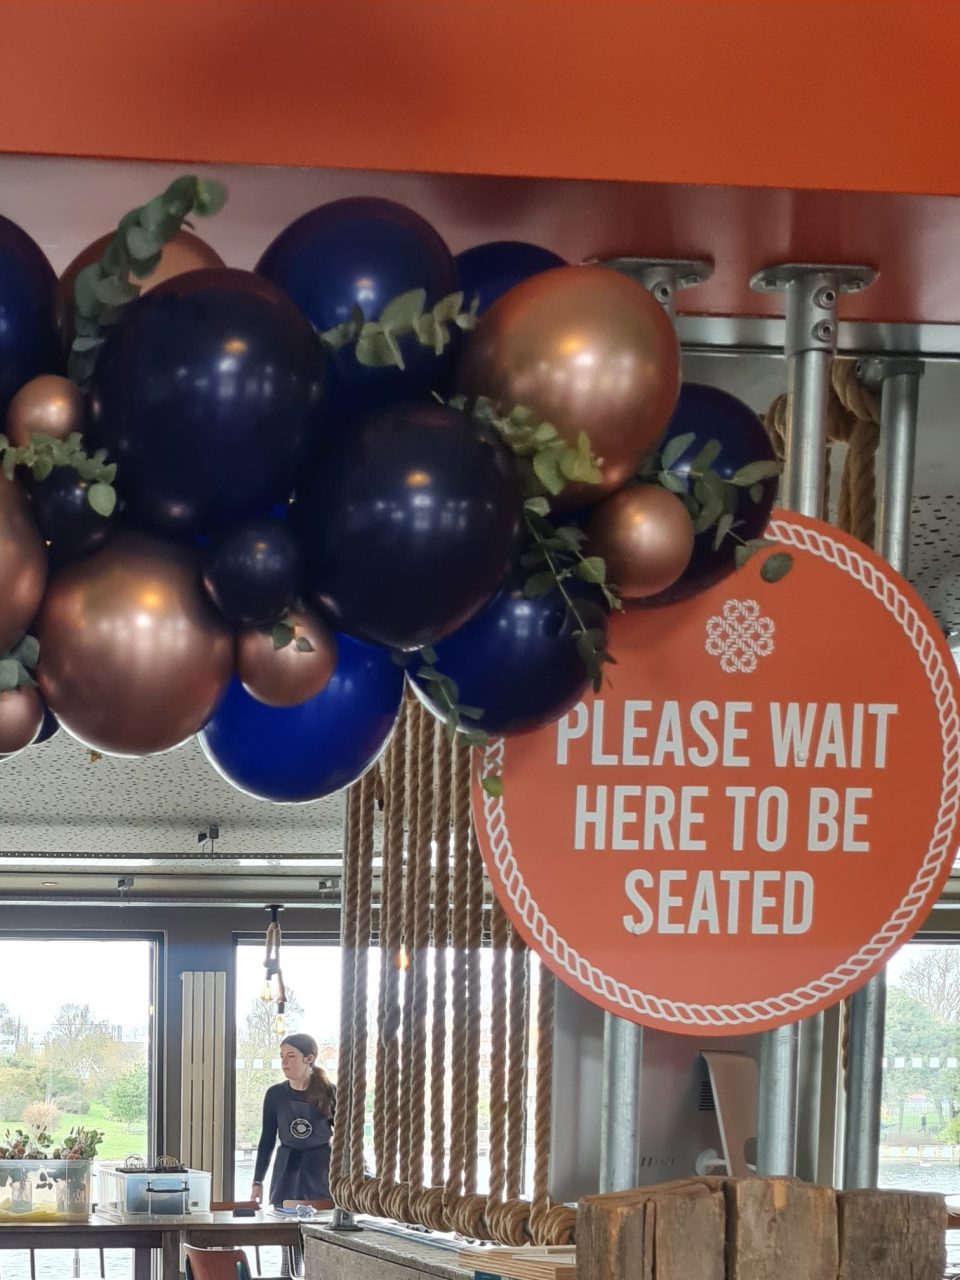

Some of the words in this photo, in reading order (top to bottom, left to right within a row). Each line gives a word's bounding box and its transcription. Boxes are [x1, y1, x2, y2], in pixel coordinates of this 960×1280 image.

[556, 700, 752, 767] PLEASE
[770, 702, 898, 768] WAIT
[574, 785, 710, 851] HERE
[725, 786, 788, 852] TO
[807, 788, 873, 853] BE
[623, 869, 814, 935] SEATED
